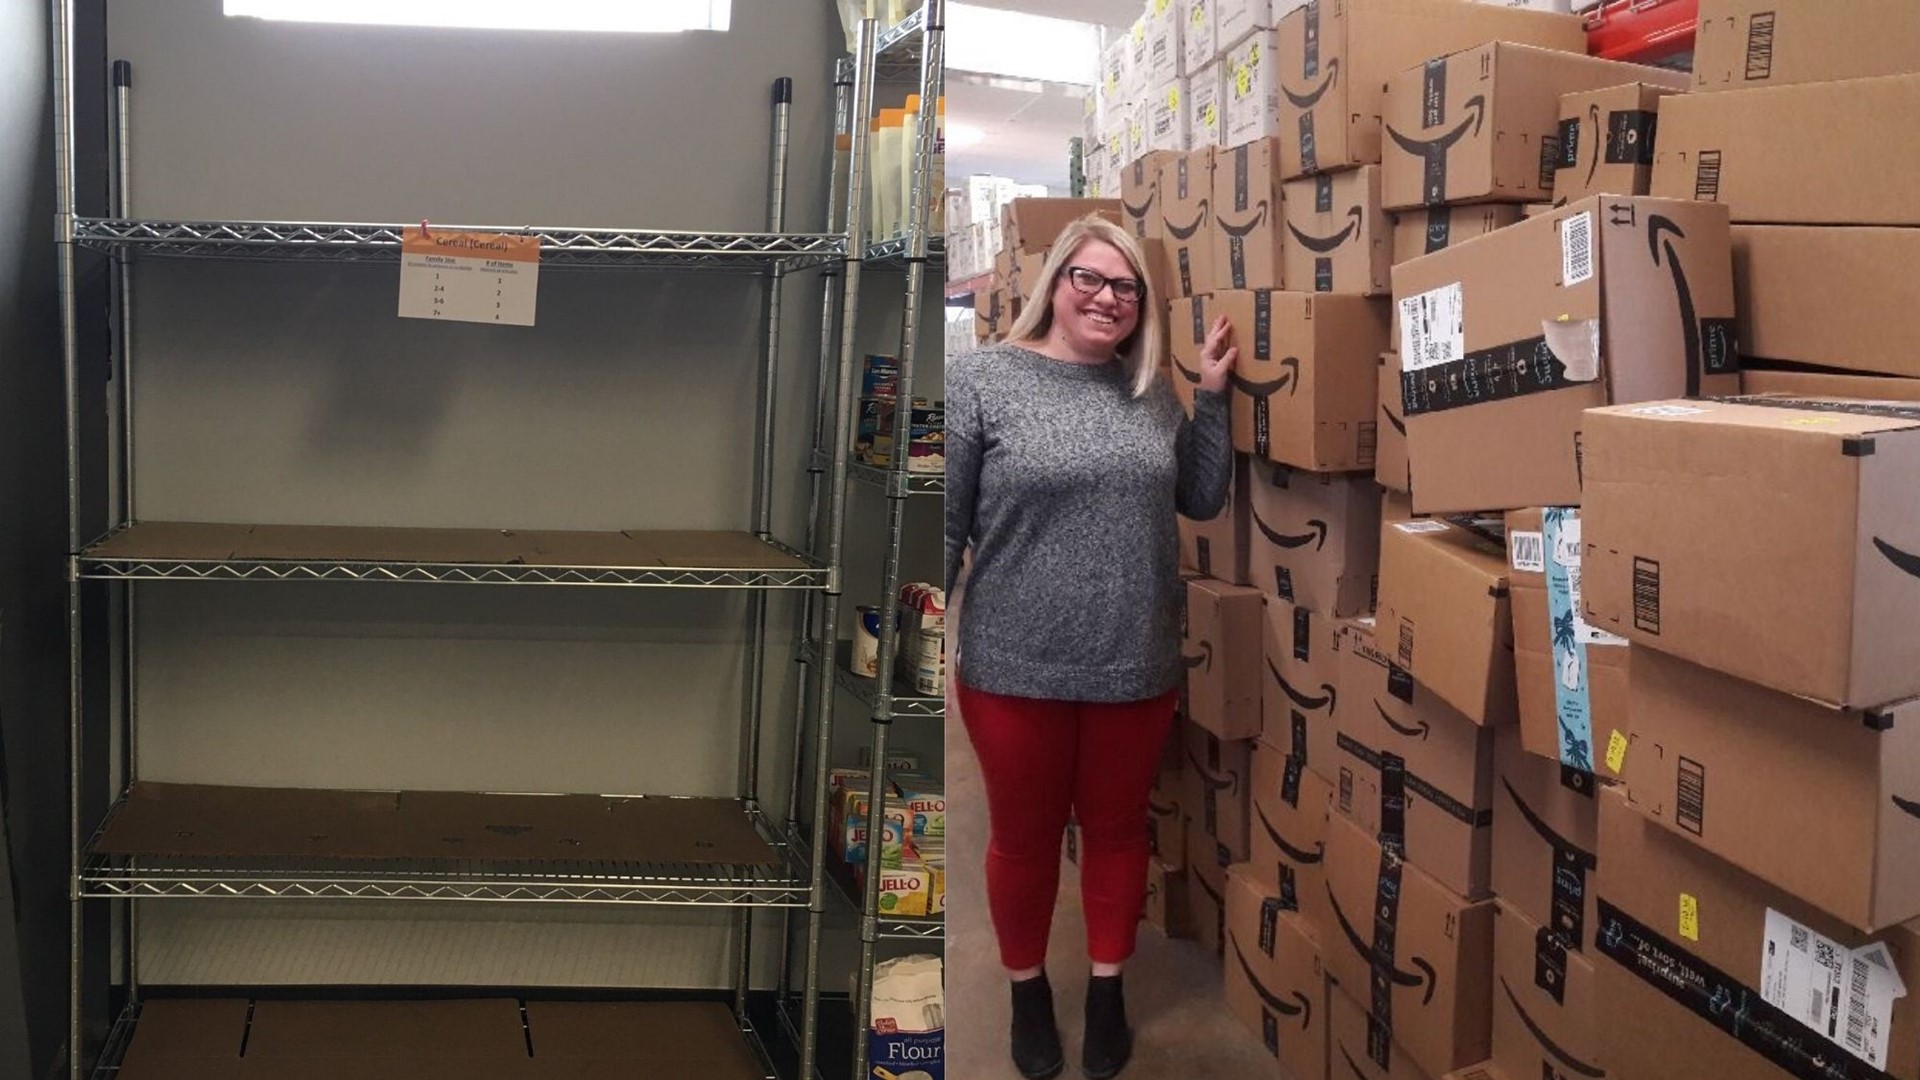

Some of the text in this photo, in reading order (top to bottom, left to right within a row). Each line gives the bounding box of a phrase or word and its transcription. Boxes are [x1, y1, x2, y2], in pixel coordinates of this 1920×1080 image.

[437, 237, 507, 252] Cereal (Cereal)
[425, 255, 444, 263] Family
[1708, 324, 1721, 368] prime
[1540, 341, 1552, 384] prime
[888, 1042, 941, 1060] Flour
